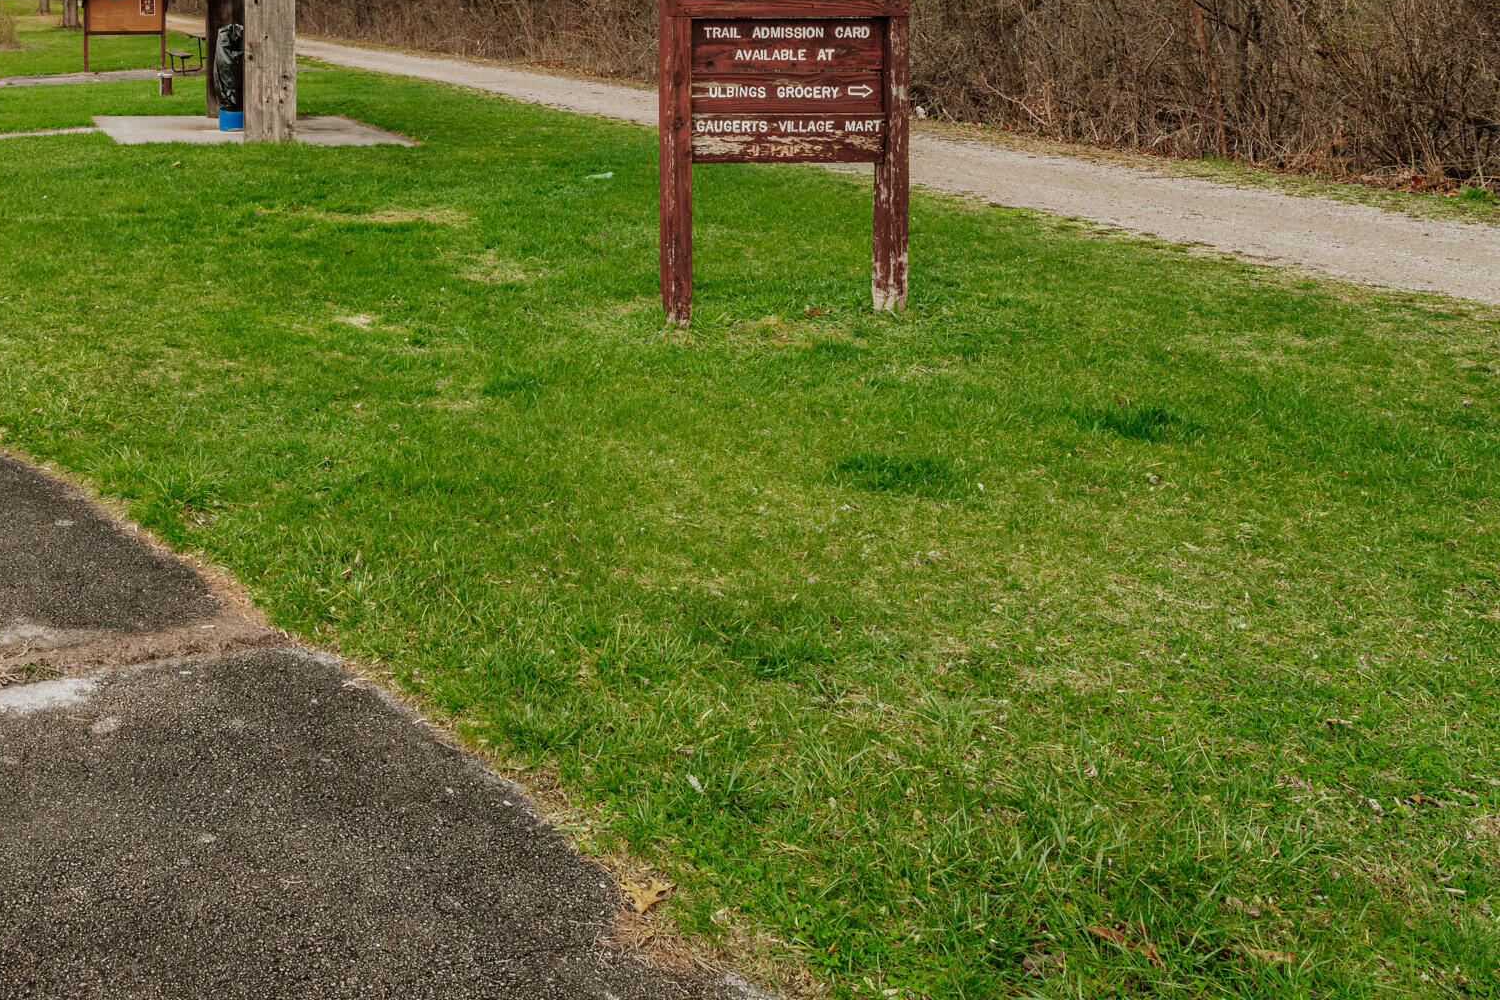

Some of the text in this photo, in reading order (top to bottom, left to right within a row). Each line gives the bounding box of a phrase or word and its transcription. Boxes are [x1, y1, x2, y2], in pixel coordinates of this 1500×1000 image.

[704, 26, 871, 39] TRAIL ADMISSION CARD
[735, 48, 836, 61] AVAILABLE AT
[709, 86, 839, 99] ULBINGS GROCERY
[696, 120, 882, 133] GAUGERTS VILLAGE MART
